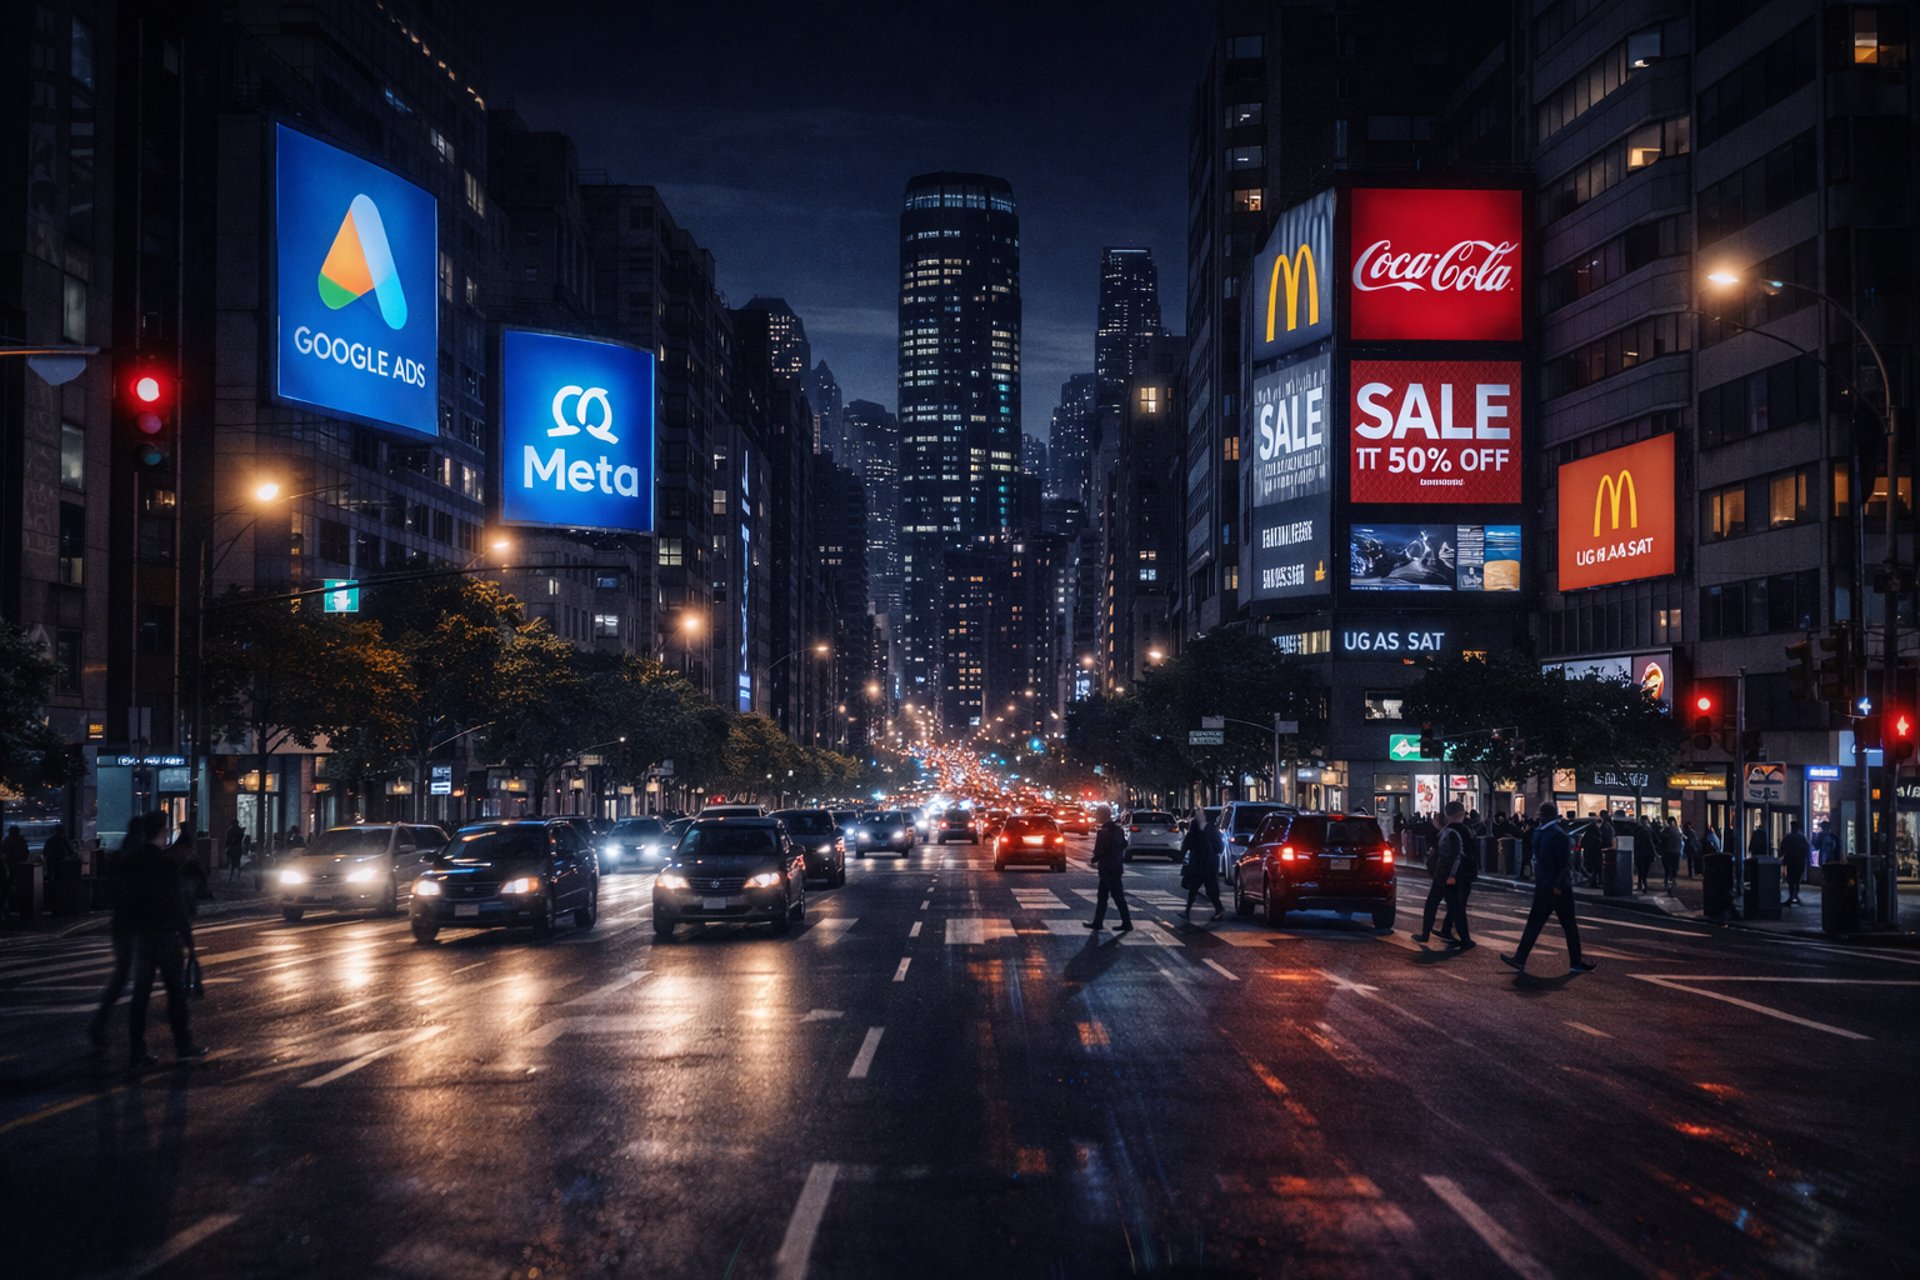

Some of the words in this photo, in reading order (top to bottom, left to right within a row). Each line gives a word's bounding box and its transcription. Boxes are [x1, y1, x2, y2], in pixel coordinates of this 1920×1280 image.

[294, 326, 389, 377] GOOGLE
[392, 356, 426, 388] ADS
[1259, 386, 1323, 461] SALE
[1354, 382, 1510, 440] SALE
[523, 445, 639, 498] Meta
[1387, 446, 1453, 474] 50%
[1459, 447, 1510, 472] OFF
[1407, 631, 1445, 651] SAT
